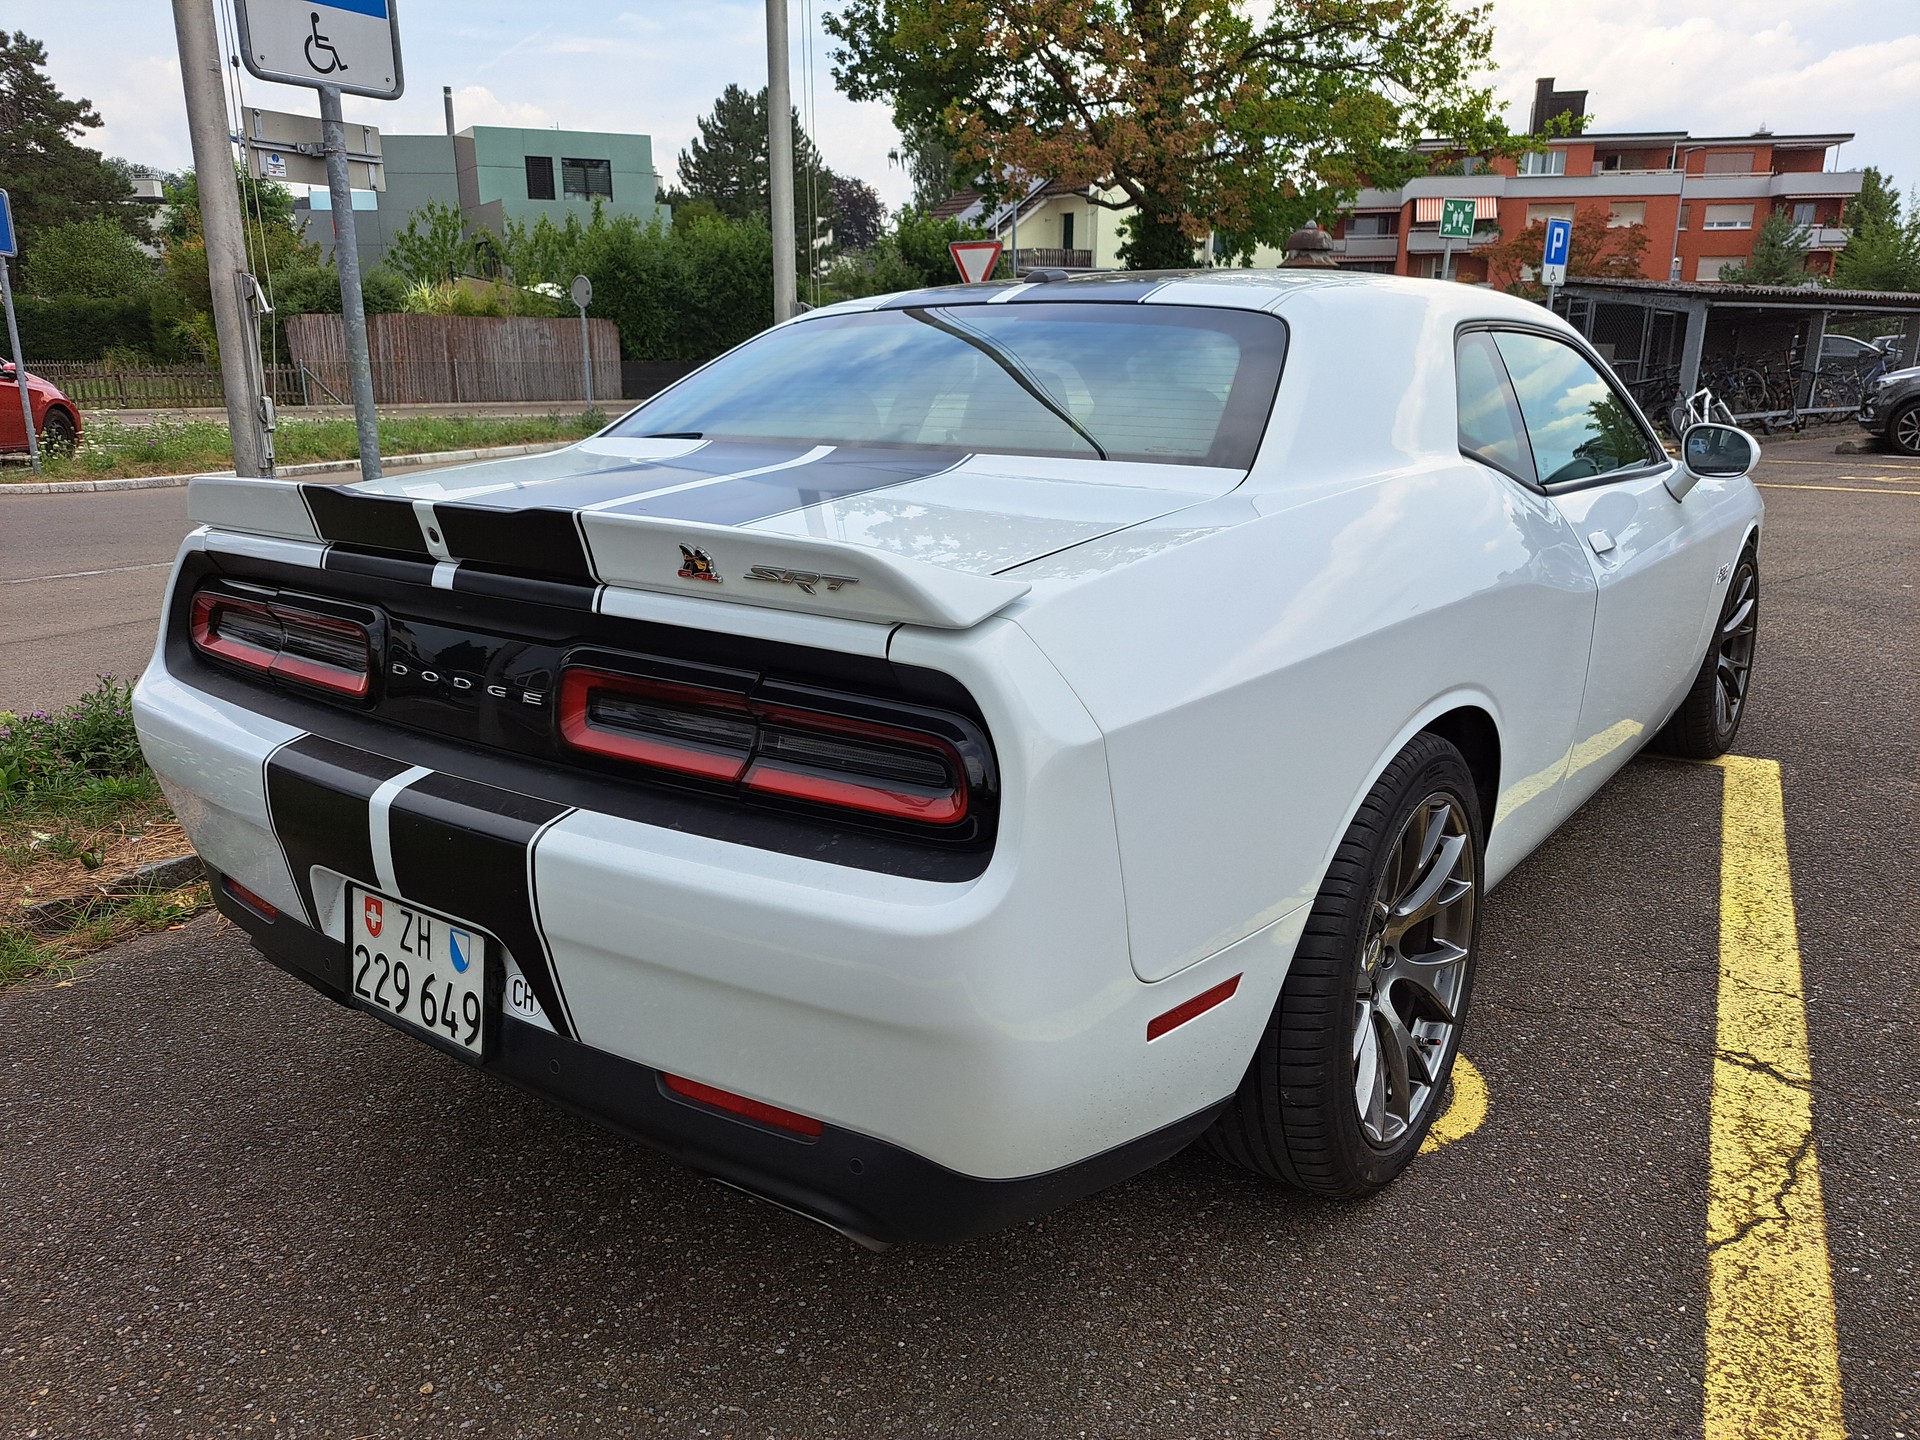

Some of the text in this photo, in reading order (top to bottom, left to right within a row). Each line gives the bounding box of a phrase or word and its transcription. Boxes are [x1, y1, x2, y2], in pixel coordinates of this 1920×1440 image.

[1551, 227, 1565, 259] P
[743, 564, 860, 595] SRT
[392, 663, 543, 706] DODGE
[400, 910, 433, 961] ZH
[354, 944, 481, 1046] 229 649
[512, 978, 535, 1013] CH
